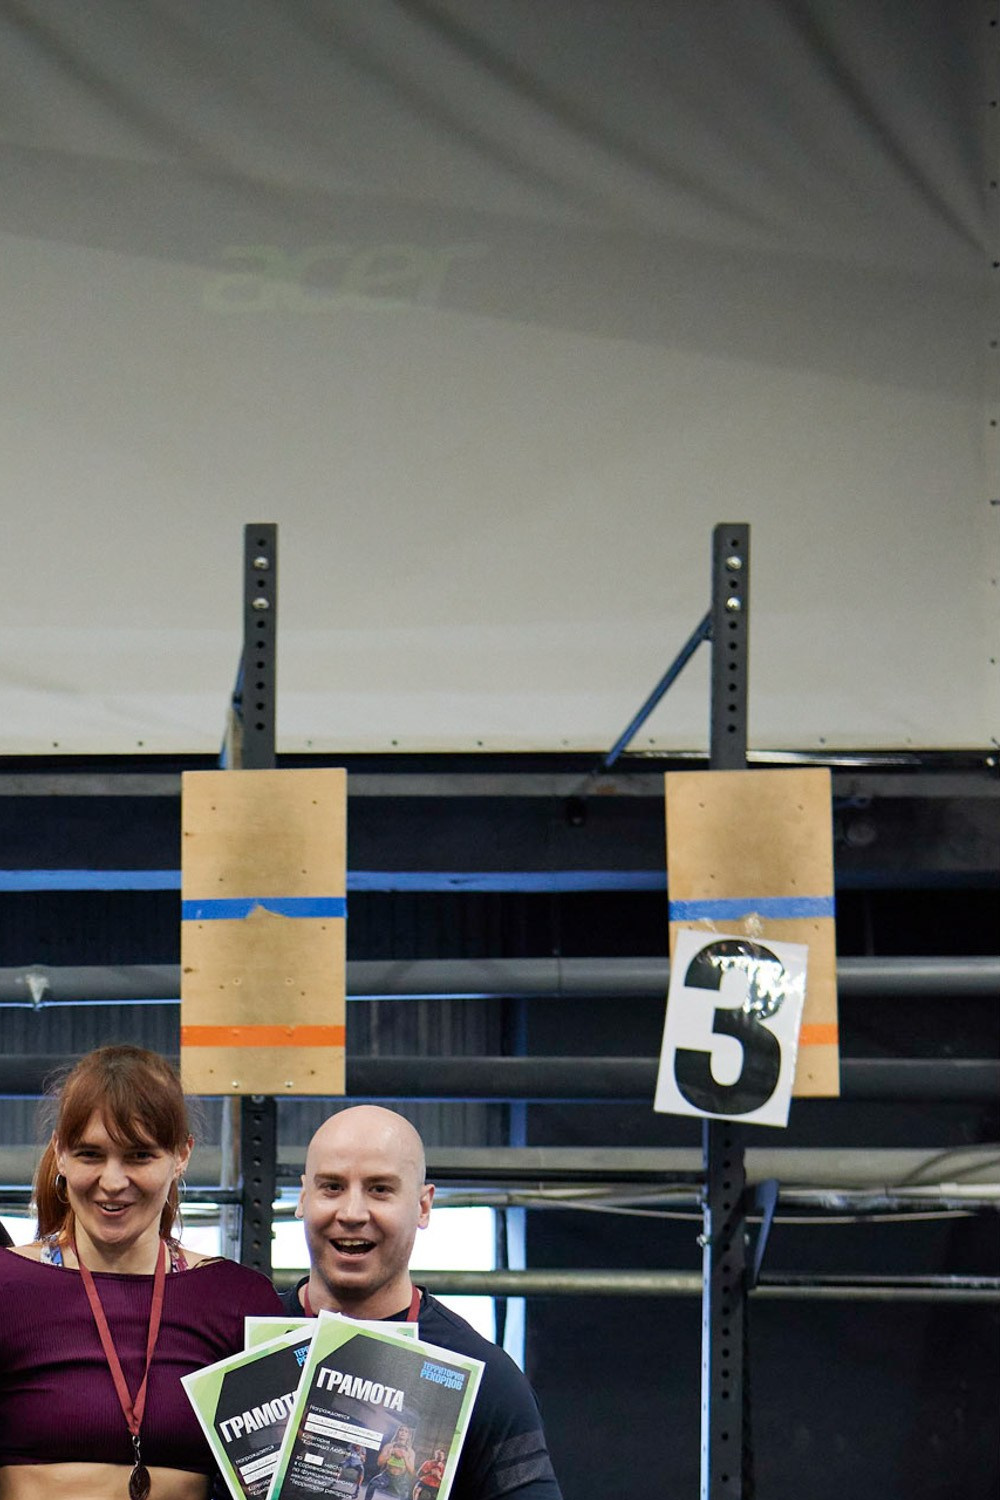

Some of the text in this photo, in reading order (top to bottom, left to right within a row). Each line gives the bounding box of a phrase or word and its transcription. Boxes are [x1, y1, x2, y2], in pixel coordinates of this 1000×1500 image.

[203, 243, 487, 313] acer
[674, 939, 786, 1115] 3
[316, 1367, 405, 1412] ГРАМОТА
[420, 1369, 464, 1391] РЕКОРДОВ
[423, 1361, 465, 1381] ТЕРРИТОРИЯ
